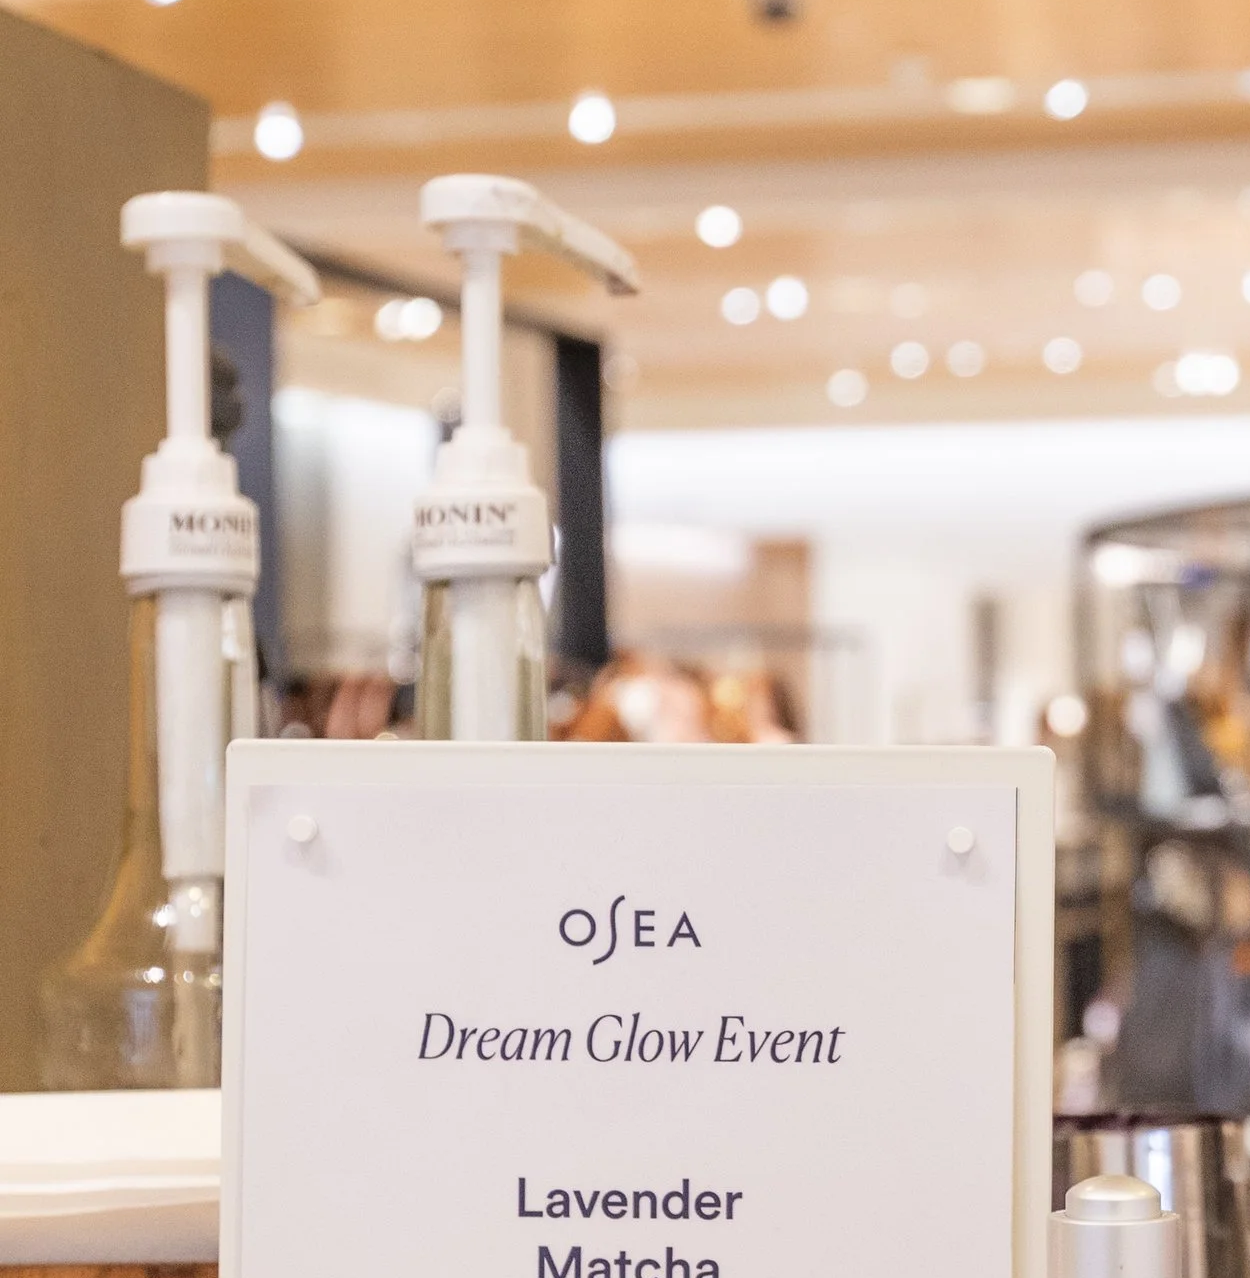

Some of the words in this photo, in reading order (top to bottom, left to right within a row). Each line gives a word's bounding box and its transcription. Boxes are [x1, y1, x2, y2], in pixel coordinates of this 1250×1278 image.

[558, 894, 702, 966] OSEA
[418, 1012, 572, 1062] Dream
[586, 1011, 705, 1063] Glow
[713, 1015, 846, 1064] Event
[517, 1176, 744, 1221] Lavender
